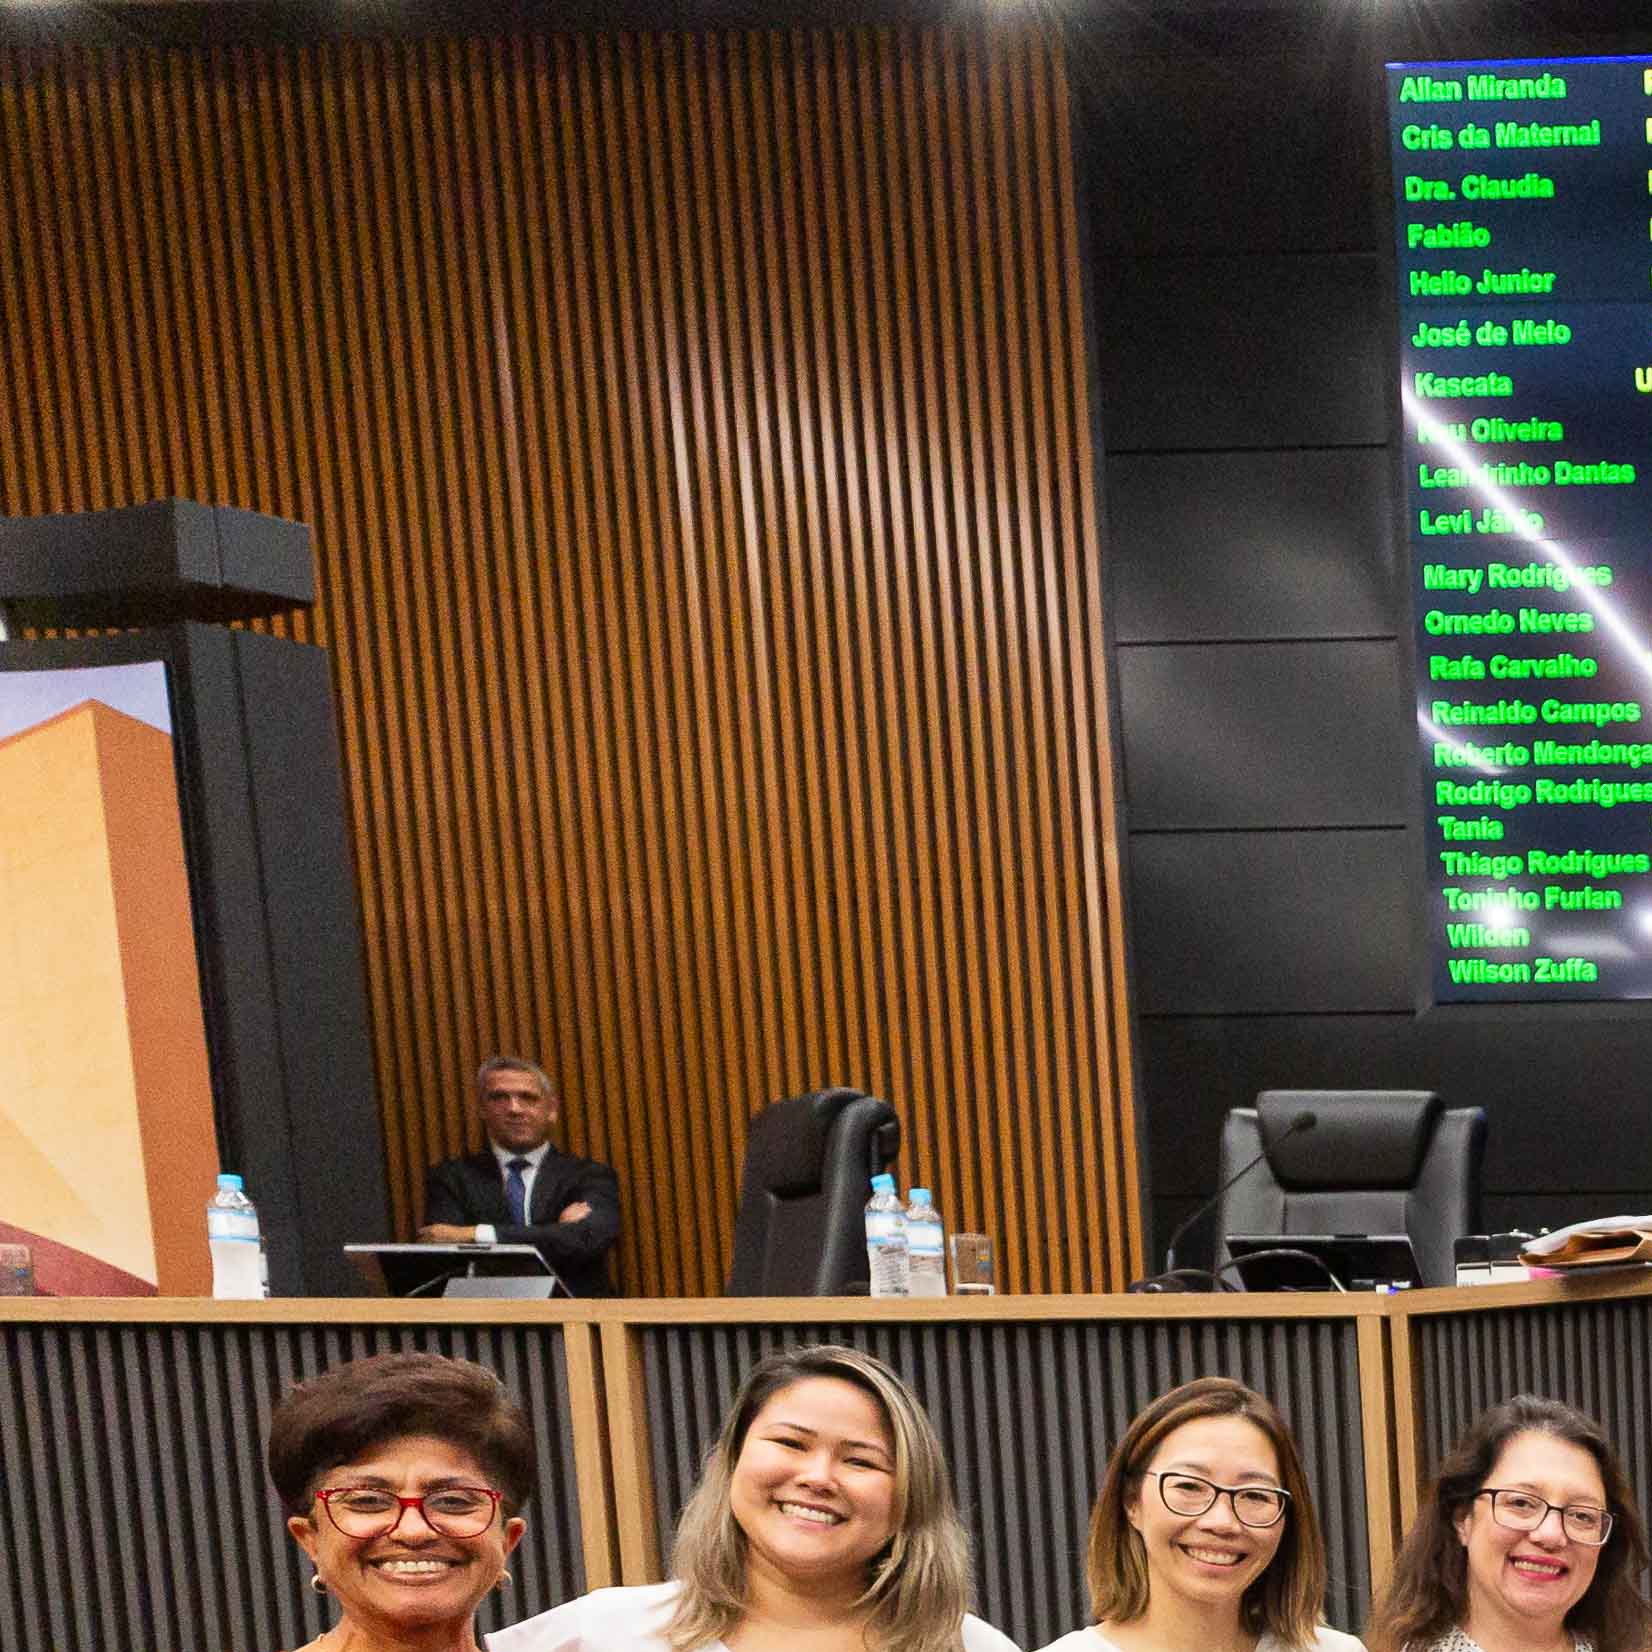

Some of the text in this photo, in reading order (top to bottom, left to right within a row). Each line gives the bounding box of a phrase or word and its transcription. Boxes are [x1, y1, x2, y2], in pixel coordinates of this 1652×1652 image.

[1400, 73, 1566, 101] Allan Miranda
[1402, 119, 1600, 150] Cris da Maternal
[1405, 174, 1554, 201] Dra. Claudia
[1407, 221, 1490, 249] Fabião
[1476, 268, 1556, 294] Junior
[1412, 319, 1571, 347] José de Melo
[1415, 372, 1512, 398] Kascata
[1471, 417, 1563, 442] Oliveira
[1554, 460, 1636, 485] Dantas
[1419, 509, 1472, 535] Levi
[1423, 565, 1483, 594] Mary
[1520, 608, 1594, 633] Neves
[1430, 653, 1597, 680] Rafa Carvalho
[1431, 699, 1641, 727] Reinaldo Campos
[1434, 742, 1530, 767] Roberto
[1436, 780, 1532, 809] Rodrigo
[1440, 850, 1650, 880] Thiago Rodrigues
[1442, 886, 1623, 911] Toninho Furlan
[1448, 958, 1598, 984] Wilson Zuffa
